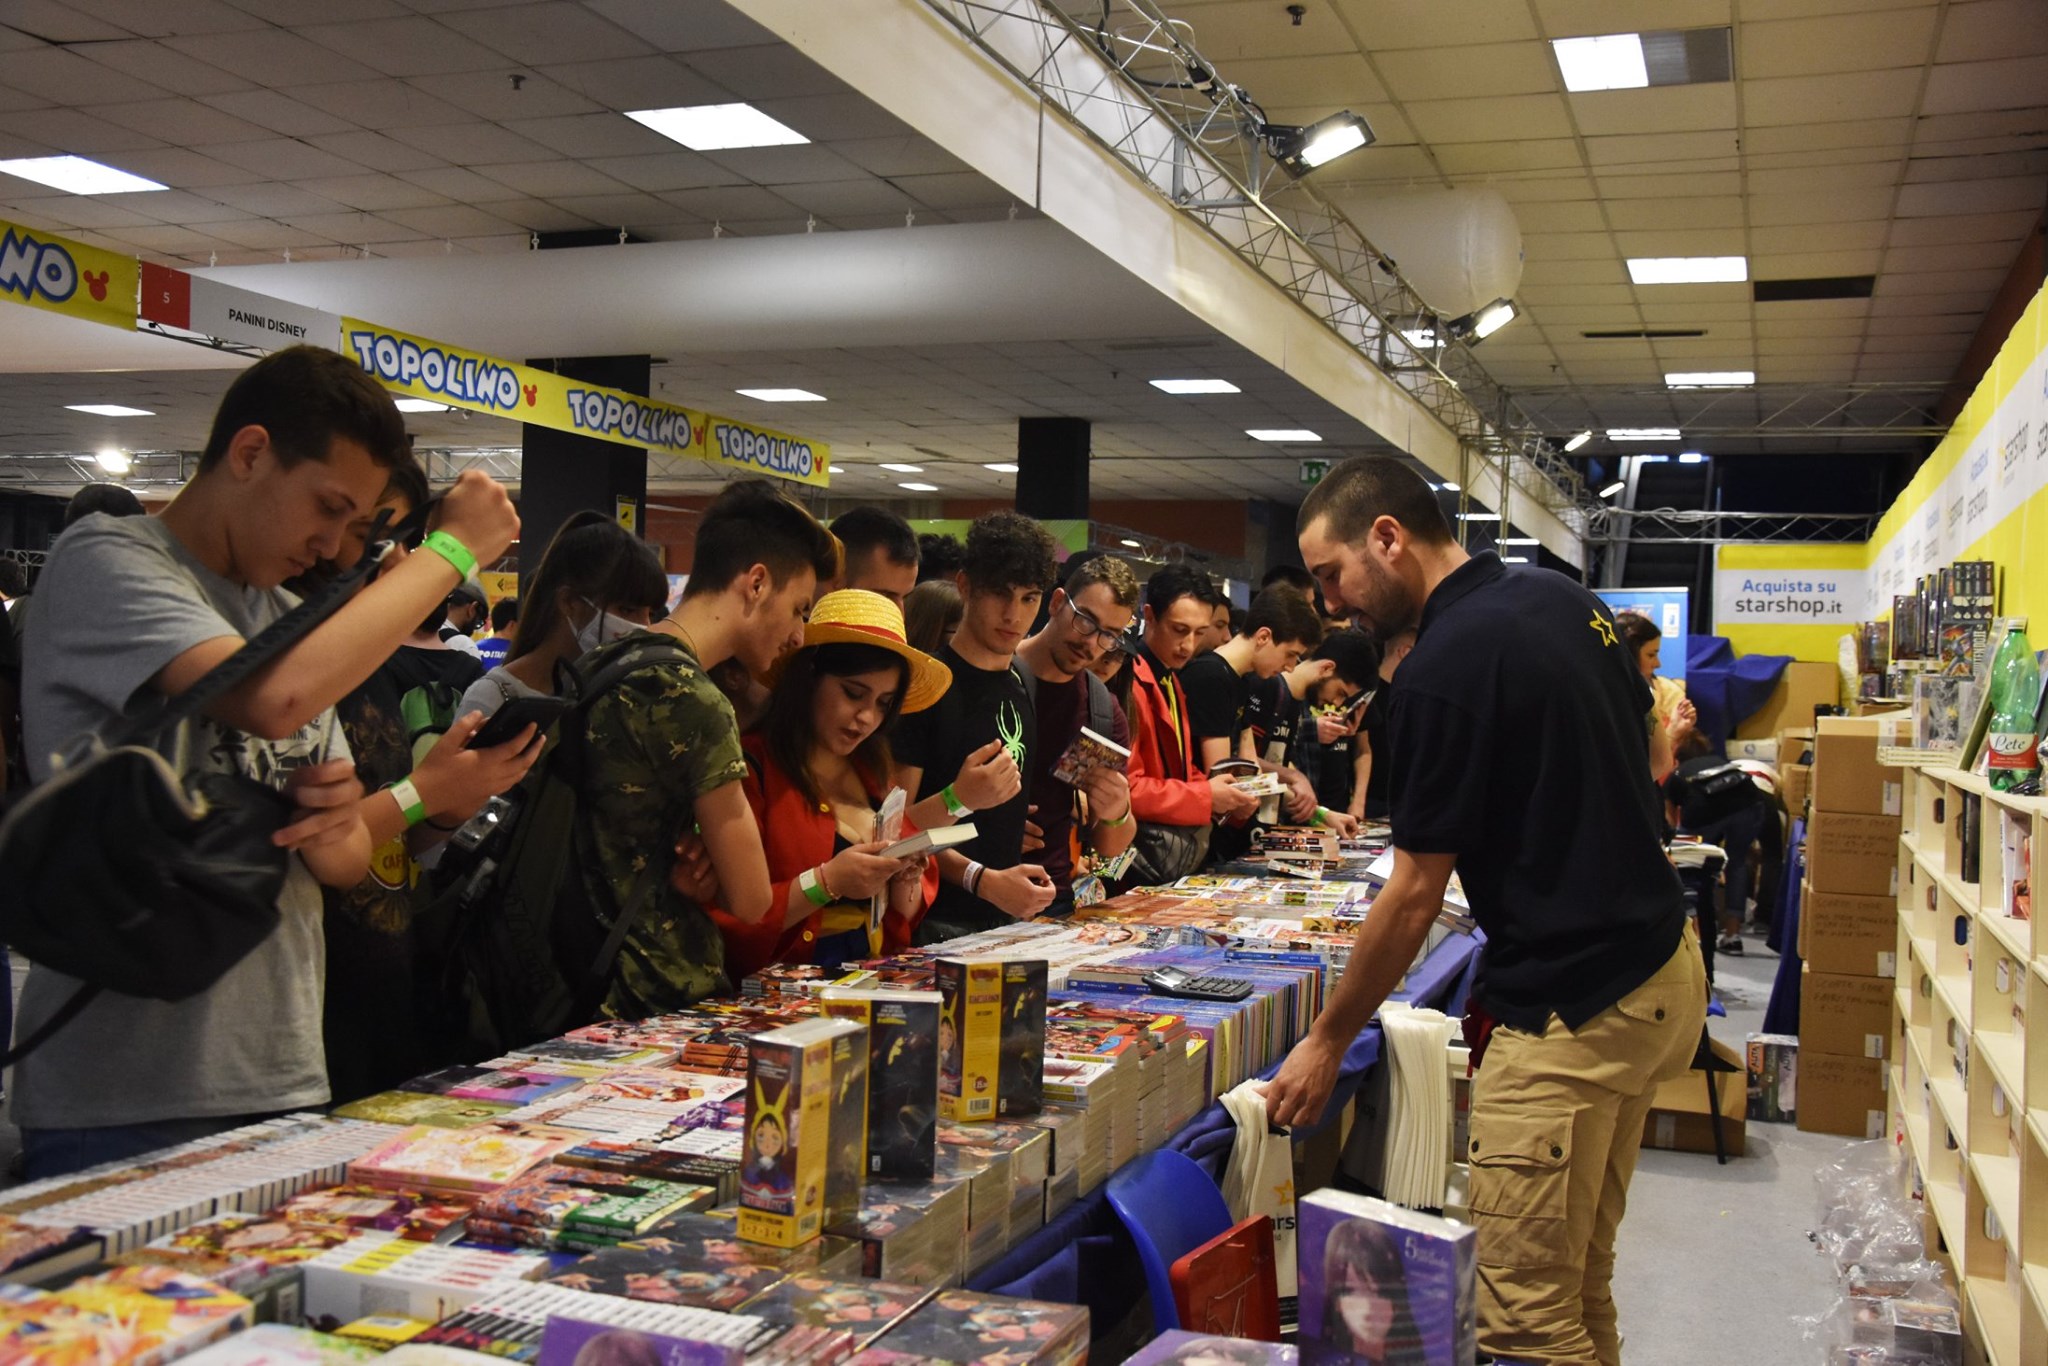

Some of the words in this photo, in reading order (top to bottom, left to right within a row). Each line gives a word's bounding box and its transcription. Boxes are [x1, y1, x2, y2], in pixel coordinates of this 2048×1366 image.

[163, 292, 171, 304] 5
[228, 308, 266, 328] PANINI
[267, 318, 307, 339] DISNEY
[350, 331, 520, 409] TOPOLINO
[567, 389, 691, 449] TOPOLINO
[716, 425, 813, 477] TOPOLINO
[1742, 579, 1813, 596] Acquista
[1817, 582, 1837, 593] su
[1735, 596, 1843, 617] starshop.it
[1993, 734, 2026, 752] Lete
